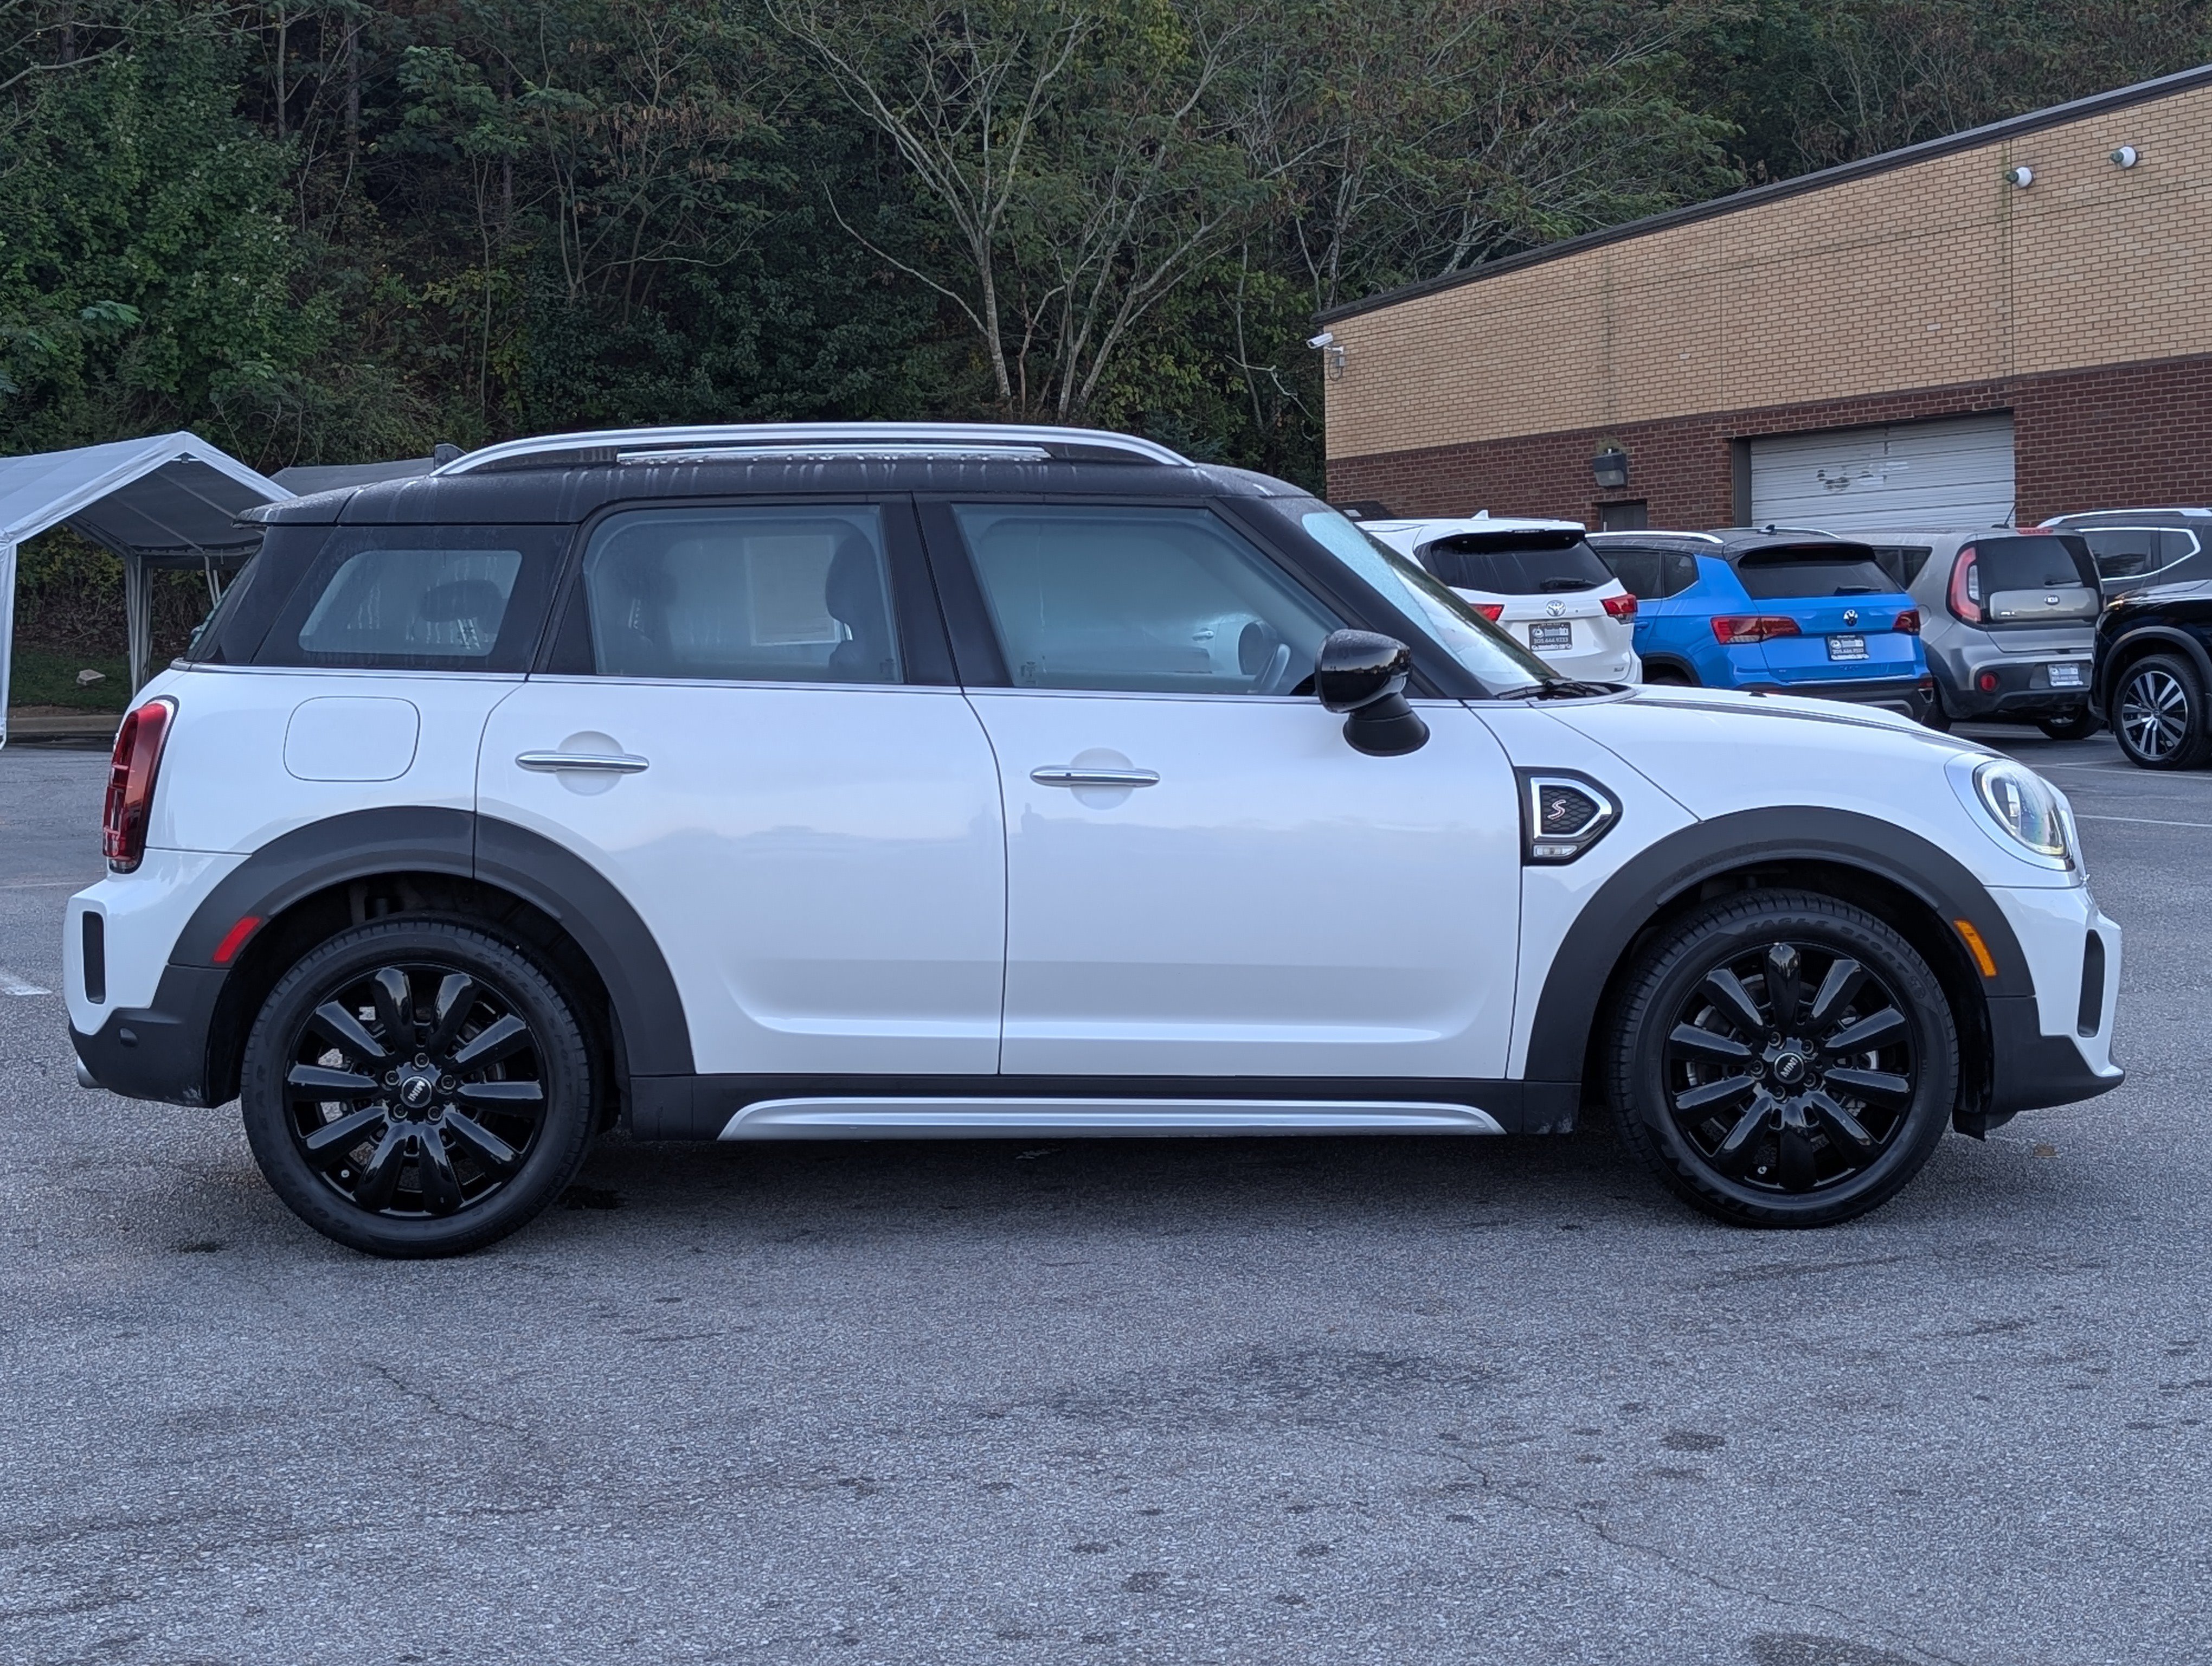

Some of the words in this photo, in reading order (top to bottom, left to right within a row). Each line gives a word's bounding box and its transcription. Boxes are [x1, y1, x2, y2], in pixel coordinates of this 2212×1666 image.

[1547, 799, 1566, 819] S
[1744, 917, 1829, 931] EAGLE
[1840, 926, 1909, 975] SPORT
[1780, 1057, 1798, 1078] MINI
[408, 1080, 425, 1101] MINI
